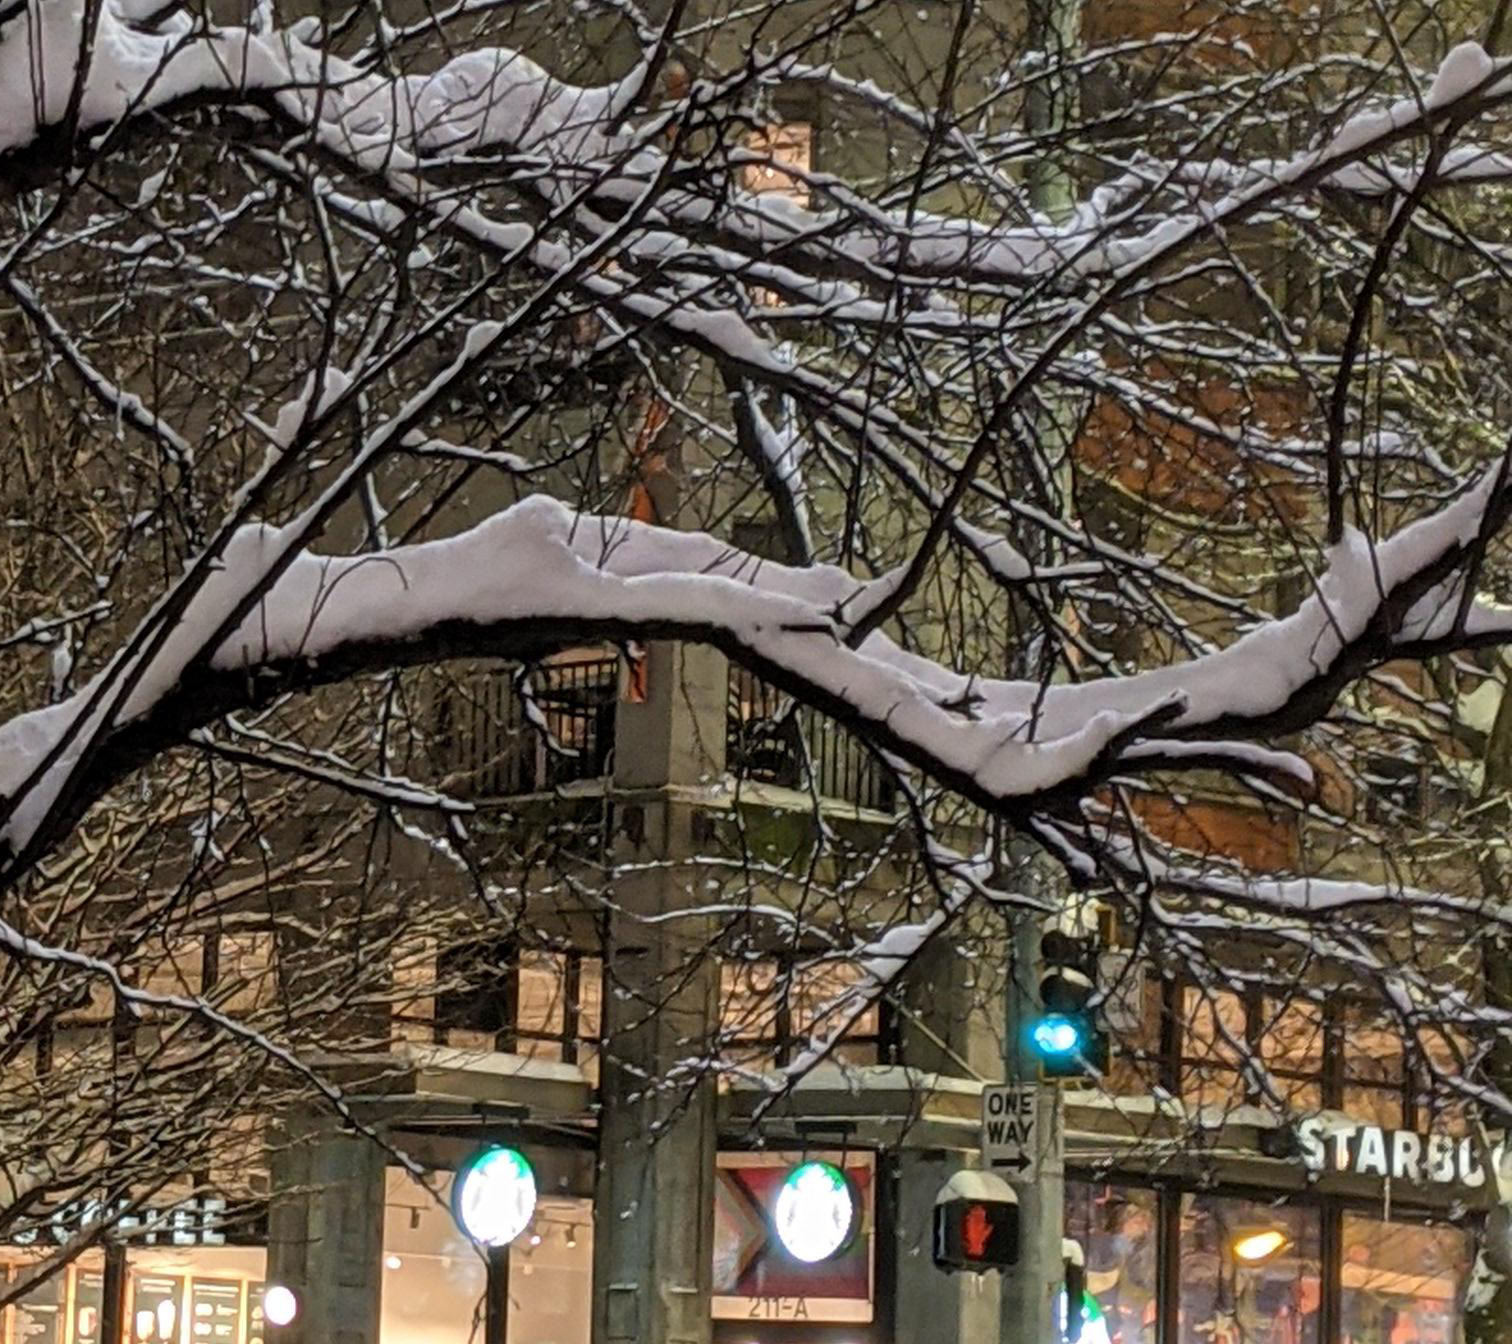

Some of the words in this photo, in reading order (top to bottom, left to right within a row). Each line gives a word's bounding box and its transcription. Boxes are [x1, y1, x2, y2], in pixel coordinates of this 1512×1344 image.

[988, 1093, 1034, 1115] ONE
[987, 1120, 1034, 1145] WAY
[747, 1296, 809, 1318] 211-A
